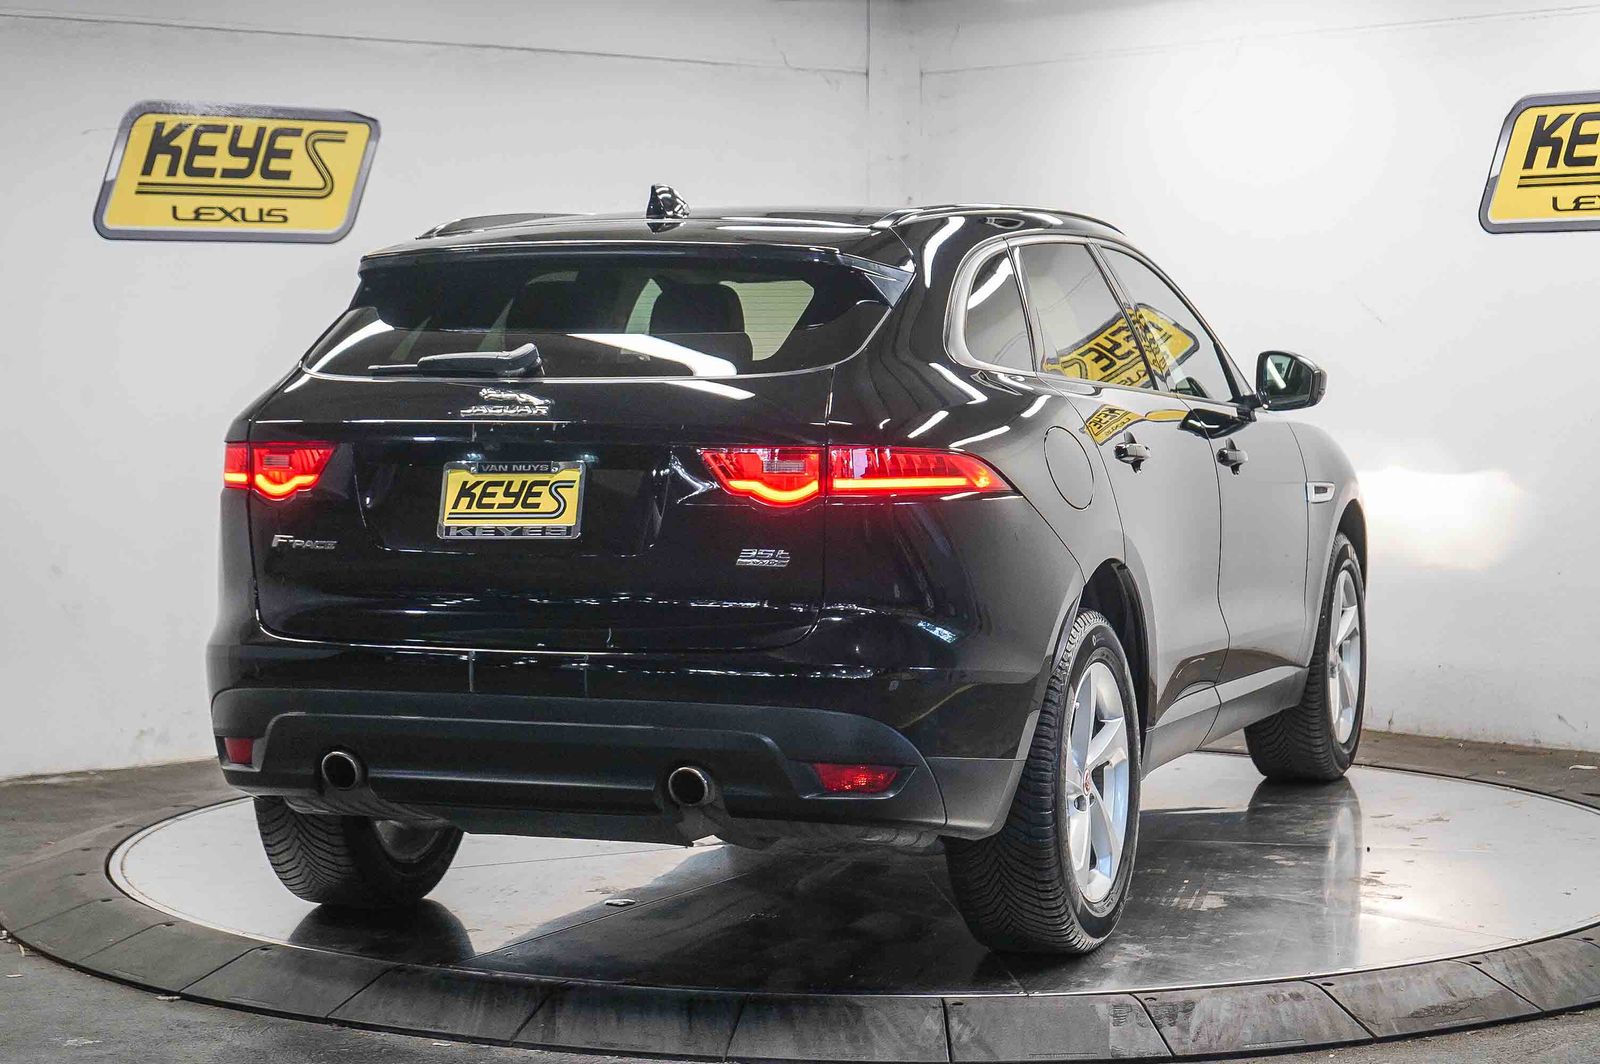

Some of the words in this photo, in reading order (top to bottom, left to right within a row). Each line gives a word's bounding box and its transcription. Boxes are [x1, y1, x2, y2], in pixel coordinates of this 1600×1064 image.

[137, 121, 348, 199] KEYES
[172, 206, 288, 223] LEXUS
[460, 405, 549, 417] JAGUAR
[481, 464, 508, 472] VAN
[512, 464, 549, 472] NUYS
[447, 480, 576, 520] KEYES
[450, 526, 567, 536] KEYES
